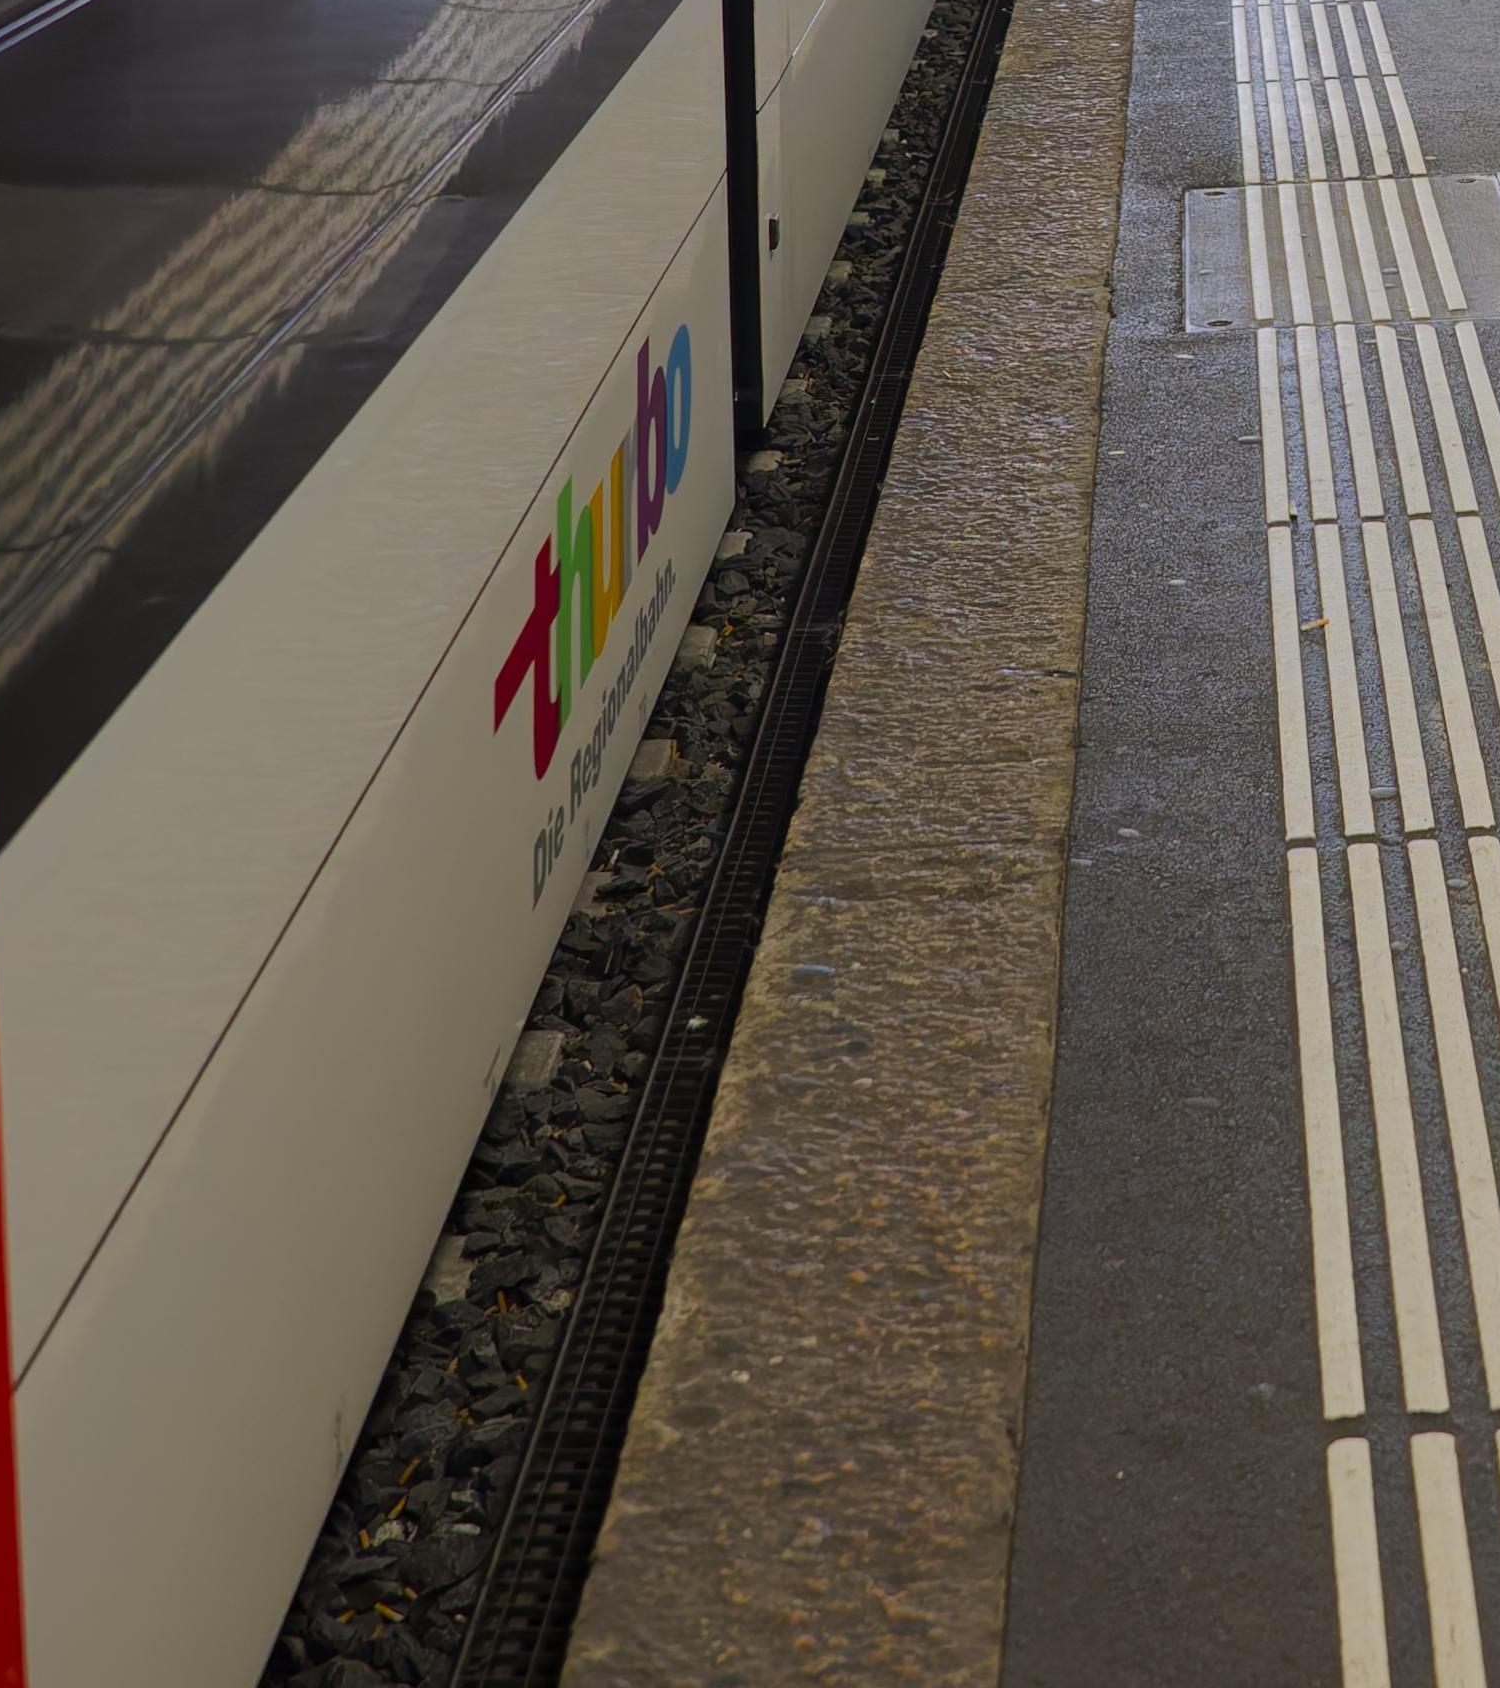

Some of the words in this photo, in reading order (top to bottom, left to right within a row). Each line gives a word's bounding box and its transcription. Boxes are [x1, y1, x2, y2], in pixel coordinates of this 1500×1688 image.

[493, 323, 691, 781] thurbo
[532, 794, 565, 913] Die
[569, 556, 678, 825] Regionalbahn.
